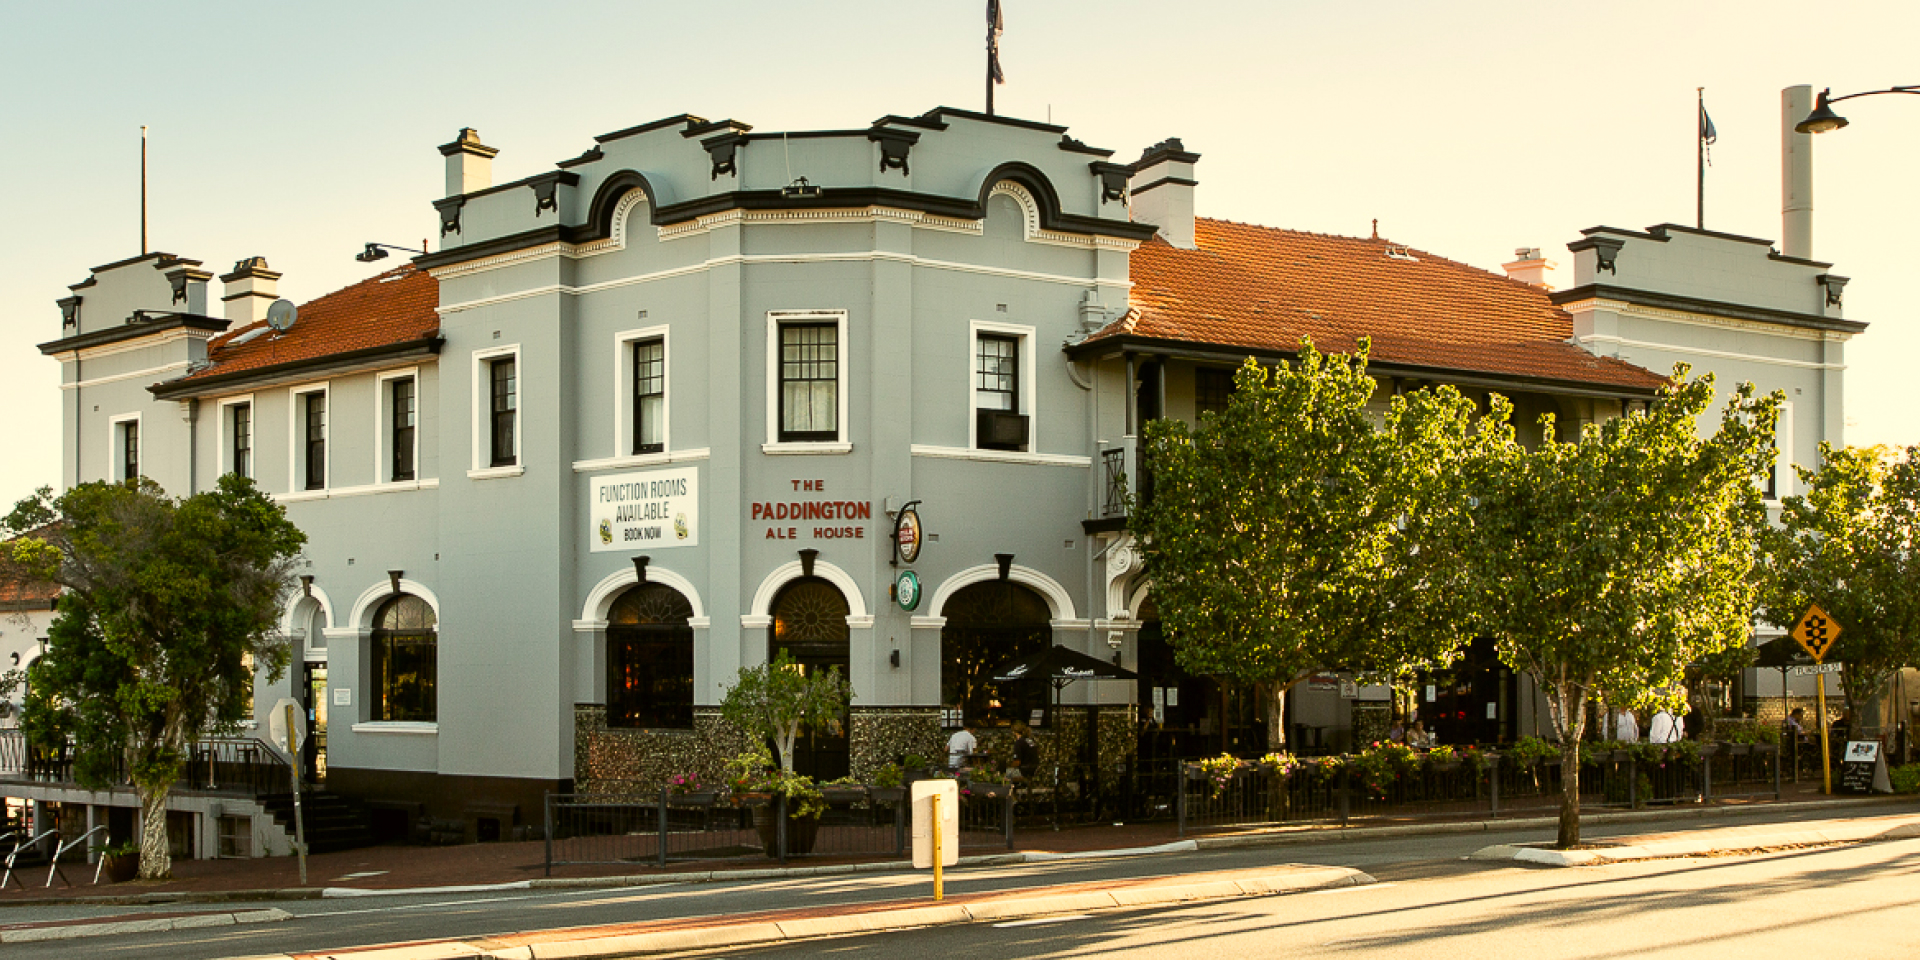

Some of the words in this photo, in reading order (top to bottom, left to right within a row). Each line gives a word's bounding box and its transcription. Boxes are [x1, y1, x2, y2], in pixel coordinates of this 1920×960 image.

[600, 482, 648, 503] FUNCTION
[651, 478, 687, 498] ROOMS
[791, 479, 825, 491] THE
[616, 501, 670, 523] AVAILABLE
[752, 501, 871, 520] PADDINGTON
[624, 527, 644, 541] BOOK
[644, 526, 662, 540] NOW
[766, 527, 797, 539] ALE
[813, 526, 864, 539] HOUSE
